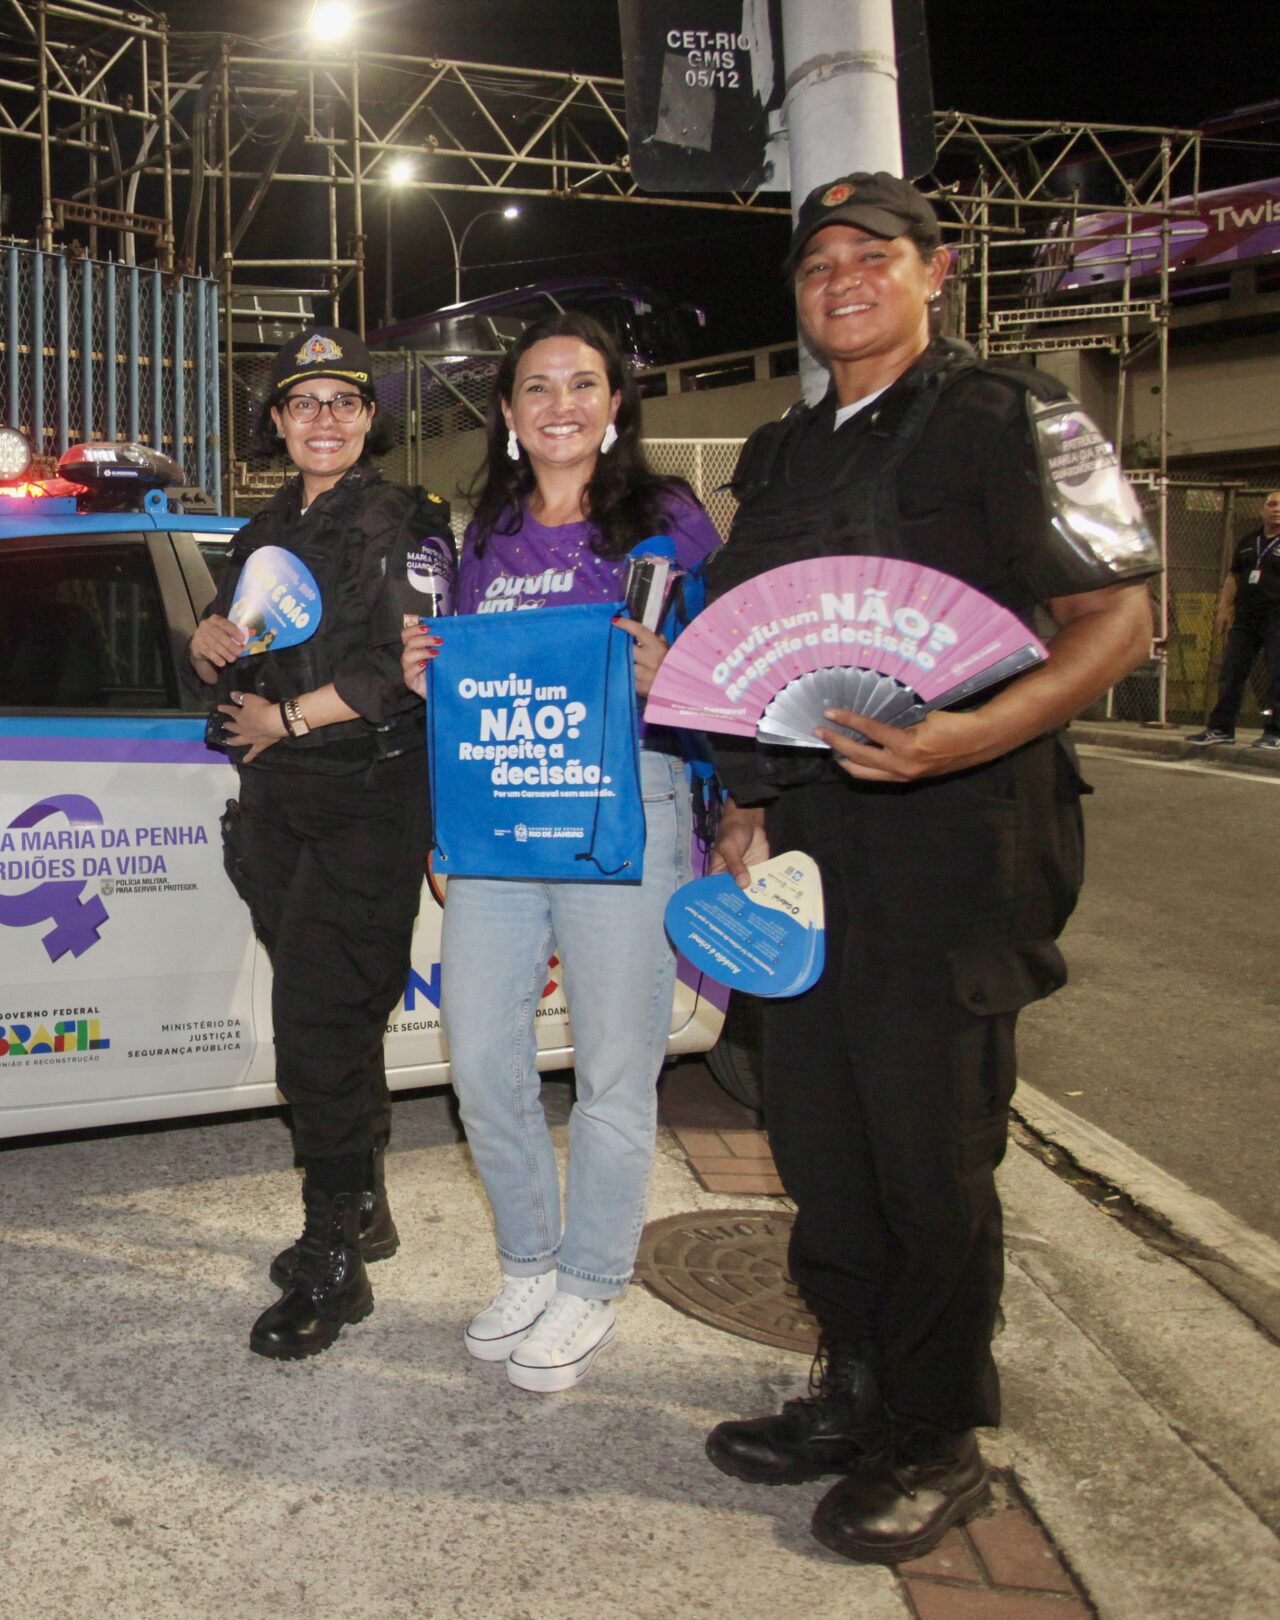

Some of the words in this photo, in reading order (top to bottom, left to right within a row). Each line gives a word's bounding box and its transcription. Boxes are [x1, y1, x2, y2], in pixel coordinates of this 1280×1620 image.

[667, 30, 751, 50] CET-RIO
[688, 51, 736, 69] GMS
[685, 70, 740, 88] 05/12
[485, 571, 574, 598] Ouviu
[477, 597, 515, 614] um
[712, 620, 781, 685] Ouviu
[781, 610, 818, 630] um
[820, 588, 958, 652] NÃO?
[725, 638, 803, 702] Respeite
[804, 632, 818, 647] a
[458, 673, 532, 699] Ouviu
[535, 685, 567, 700] um
[480, 697, 587, 741] NÃO?
[459, 739, 546, 765] Respeite
[549, 742, 565, 759] a
[491, 760, 612, 785] decisão.
[20, 829, 96, 851] MARIA
[100, 828, 131, 849] DA
[135, 825, 209, 847] PENHA
[82, 856, 113, 877] DA
[116, 855, 168, 876] VIDA
[116, 877, 141, 886] POLÍCIA
[116, 886, 133, 894] PARA
[134, 885, 157, 893] SERVIR
[53, 1006, 100, 1017] FEDERAL
[536, 1006, 568, 1018] DADAN
[161, 1019, 225, 1032] MINISTÉRIO
[227, 1019, 241, 1027] DA
[386, 1024, 399, 1033] DE
[401, 1020, 440, 1032] SEGURA
[188, 1030, 233, 1043] JUSTIÇA
[127, 1046, 193, 1059] SEGURANÇA
[195, 1041, 241, 1053] PÚBLICA
[33, 1054, 100, 1066] RECONSTRUÇÃO
